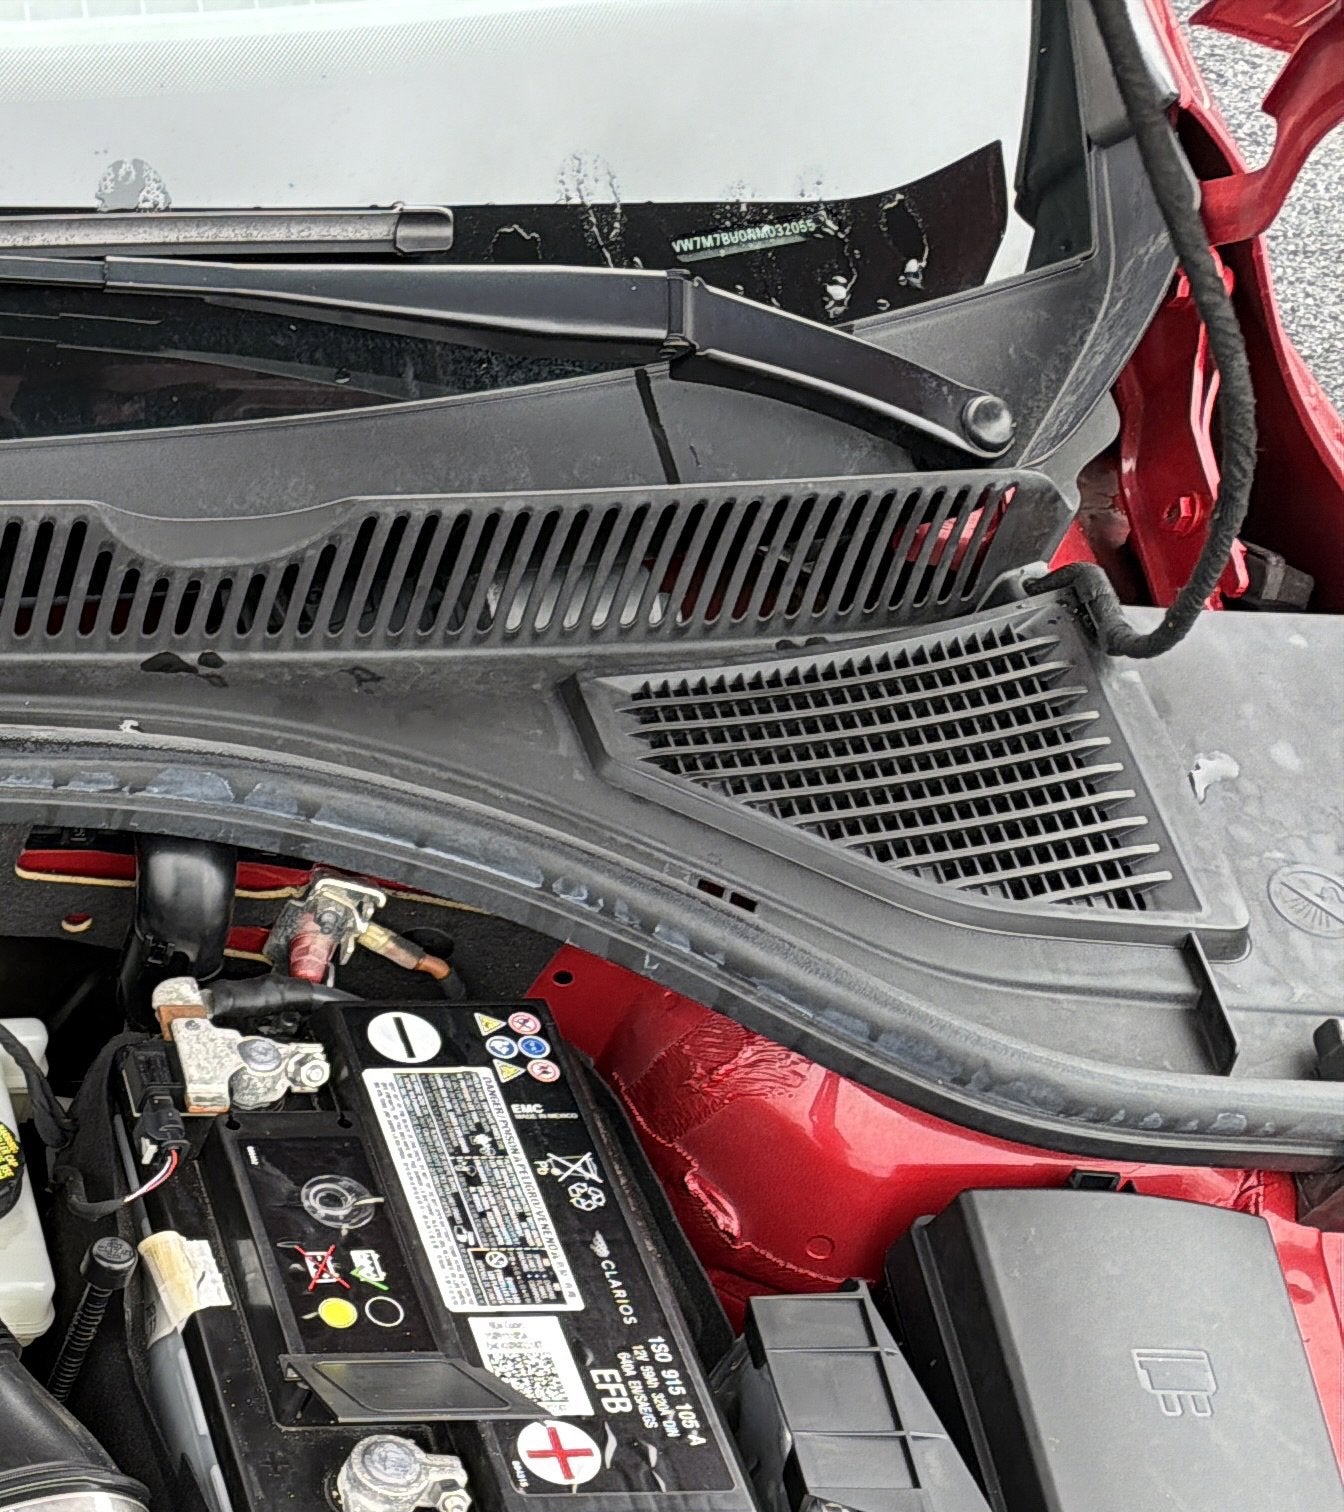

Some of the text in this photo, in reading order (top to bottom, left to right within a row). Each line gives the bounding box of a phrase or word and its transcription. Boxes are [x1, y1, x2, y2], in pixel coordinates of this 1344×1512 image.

[512, 1104, 544, 1114] EMC
[601, 1260, 637, 1325] CLARIOS
[589, 1369, 632, 1414] EFB
[632, 1345, 649, 1361] 12V
[663, 1420, 680, 1438] DIN
[661, 1369, 686, 1396] 915
[675, 1403, 700, 1429] 105
[688, 1434, 707, 1446] A
